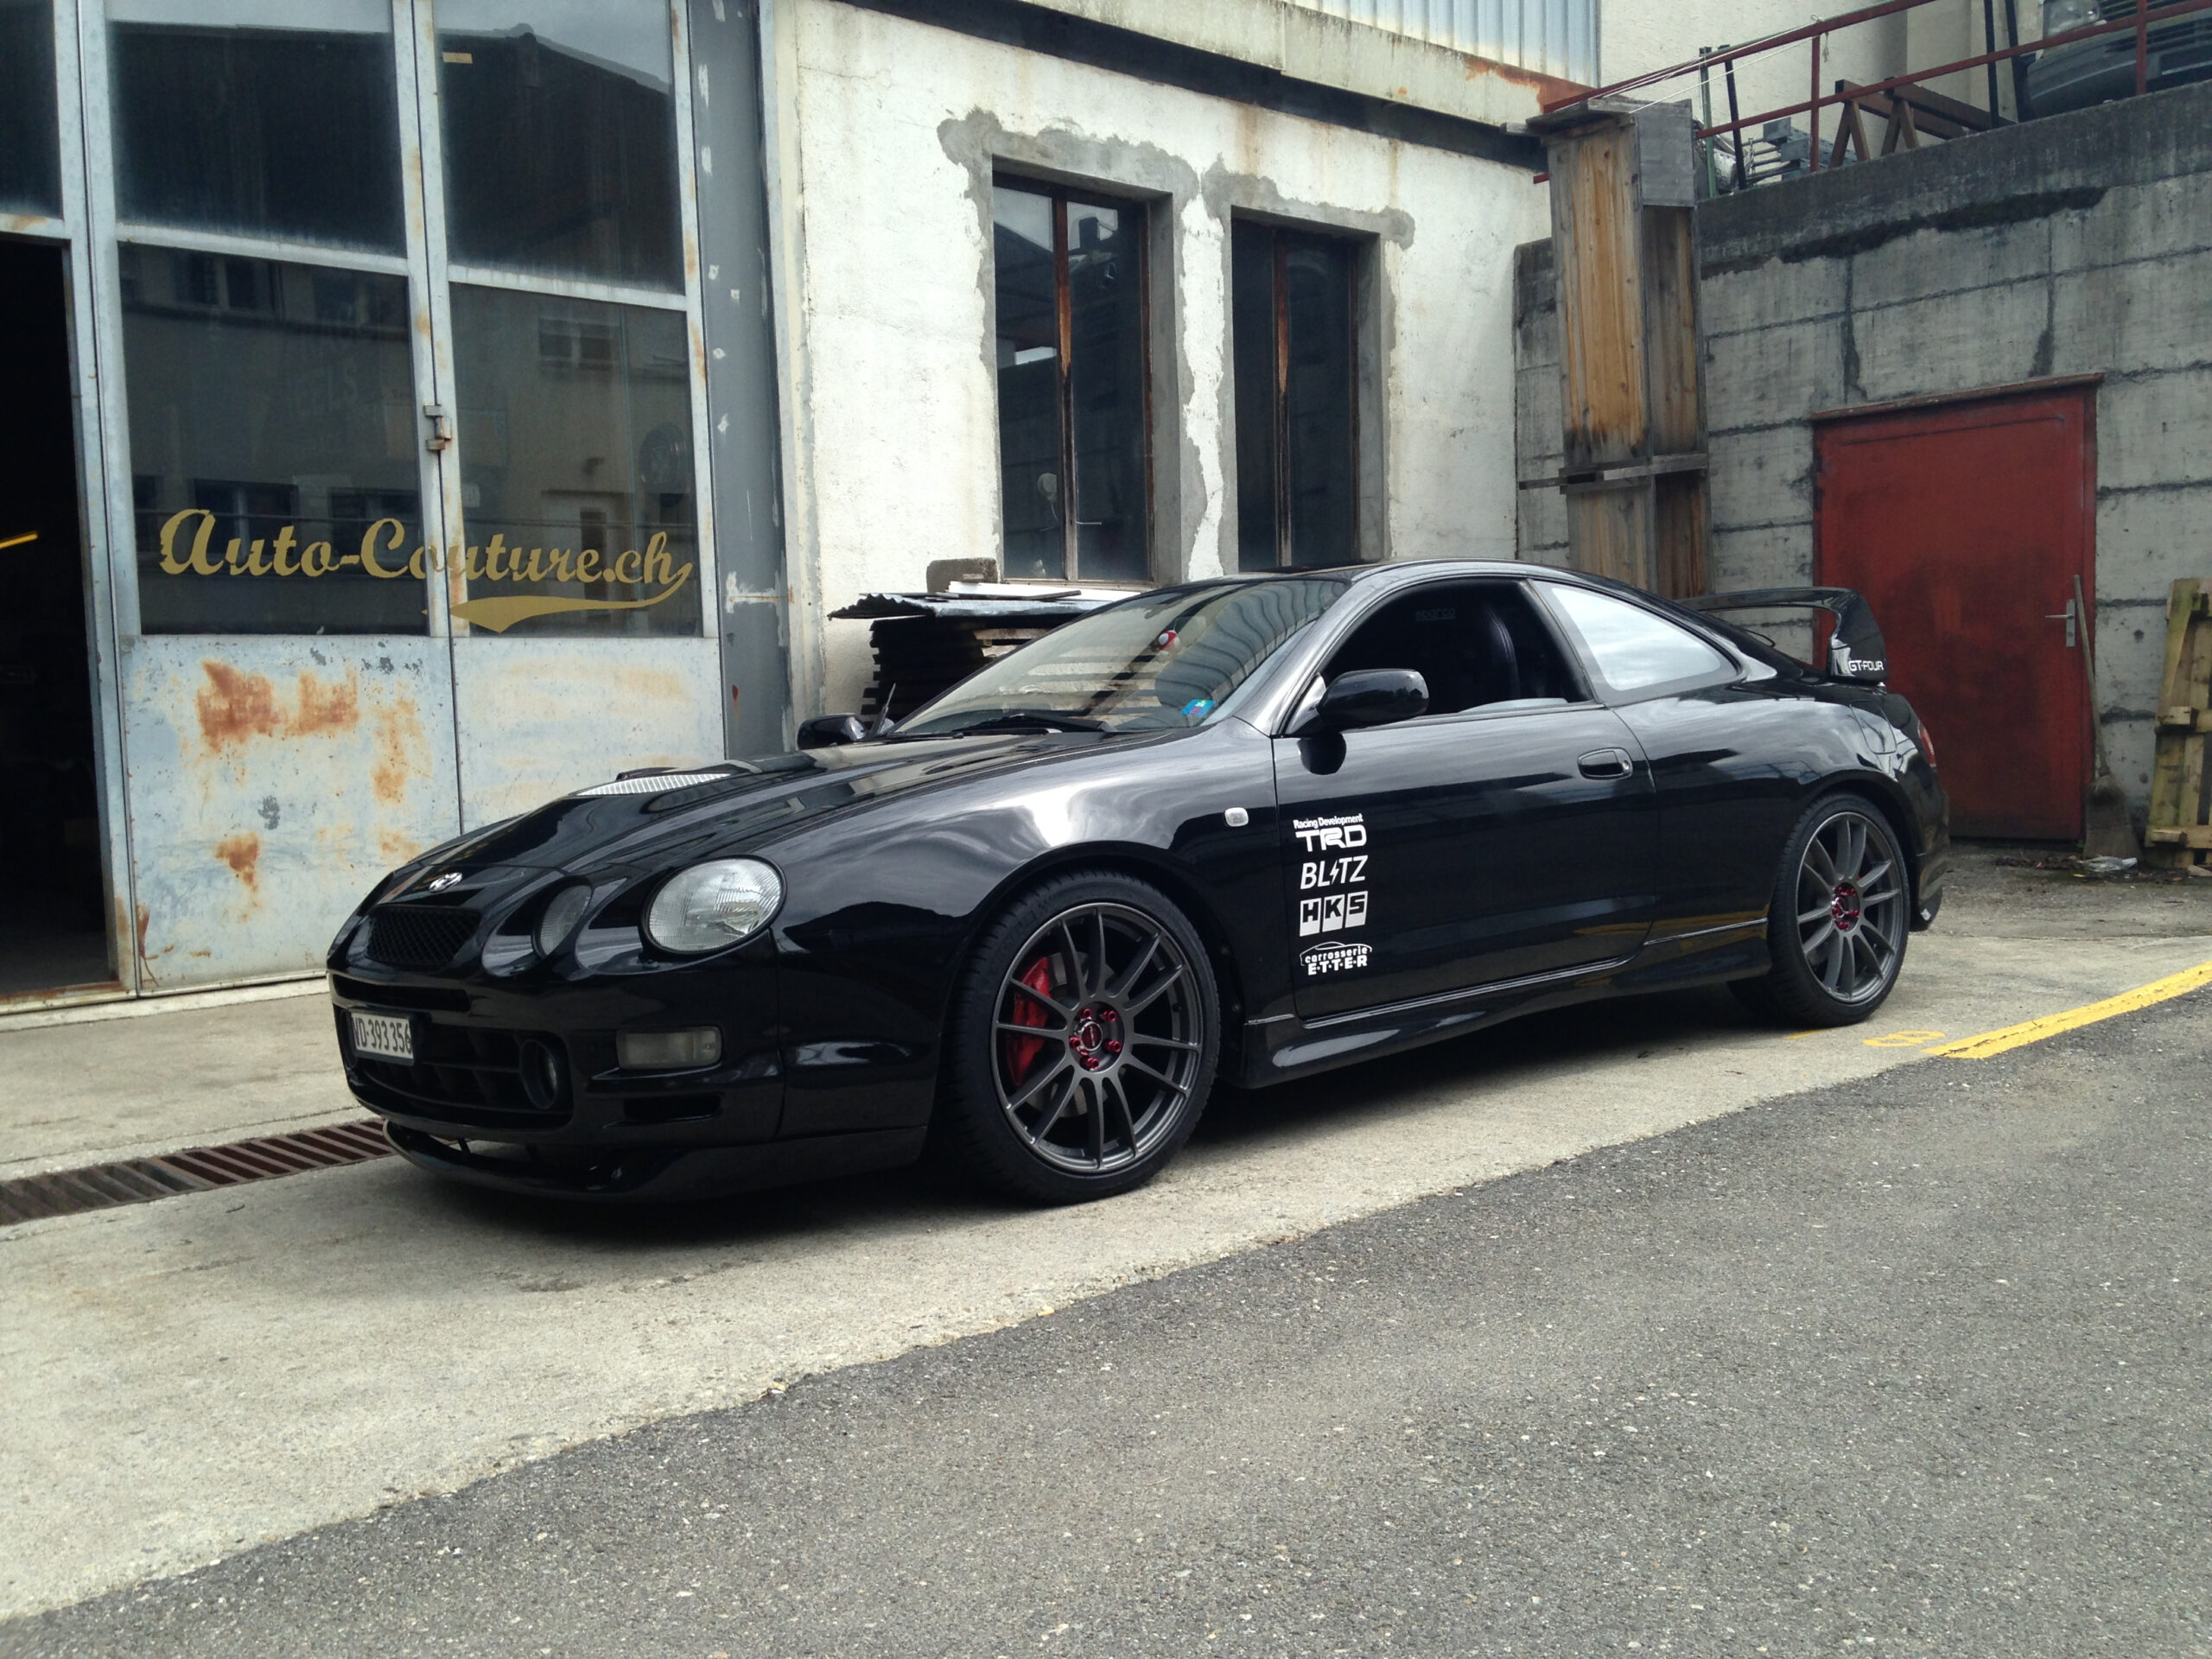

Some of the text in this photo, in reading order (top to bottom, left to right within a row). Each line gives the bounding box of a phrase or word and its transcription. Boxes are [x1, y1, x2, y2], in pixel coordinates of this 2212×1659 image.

[159, 509, 691, 584] Auto-Couture.ch
[1849, 660, 1884, 671] GT-FOUR
[1294, 813, 1363, 830] Racing Development
[1295, 824, 1367, 852] TRD
[1300, 891, 1368, 929] HKS
[1305, 945, 1368, 963] carrosserie
